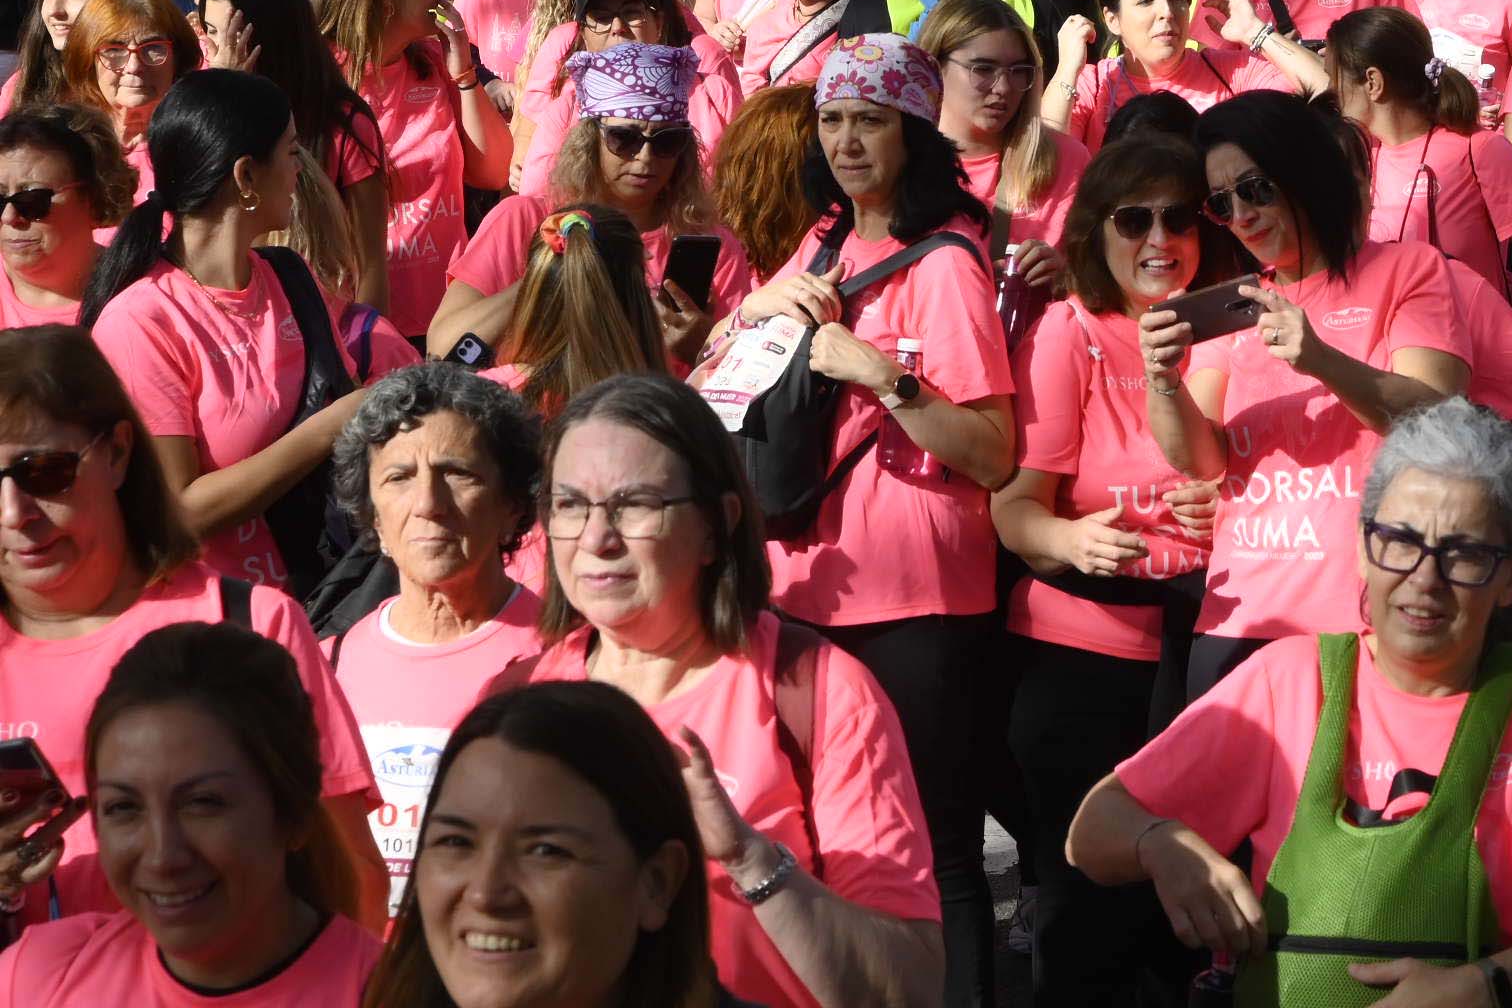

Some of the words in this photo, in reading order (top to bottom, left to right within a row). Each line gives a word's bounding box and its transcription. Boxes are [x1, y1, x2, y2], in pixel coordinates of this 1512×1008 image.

[1108, 485, 1156, 515] TU
[1227, 465, 1359, 505] DORSAL
[1234, 515, 1320, 548] SUMA
[378, 802, 421, 829] 01
